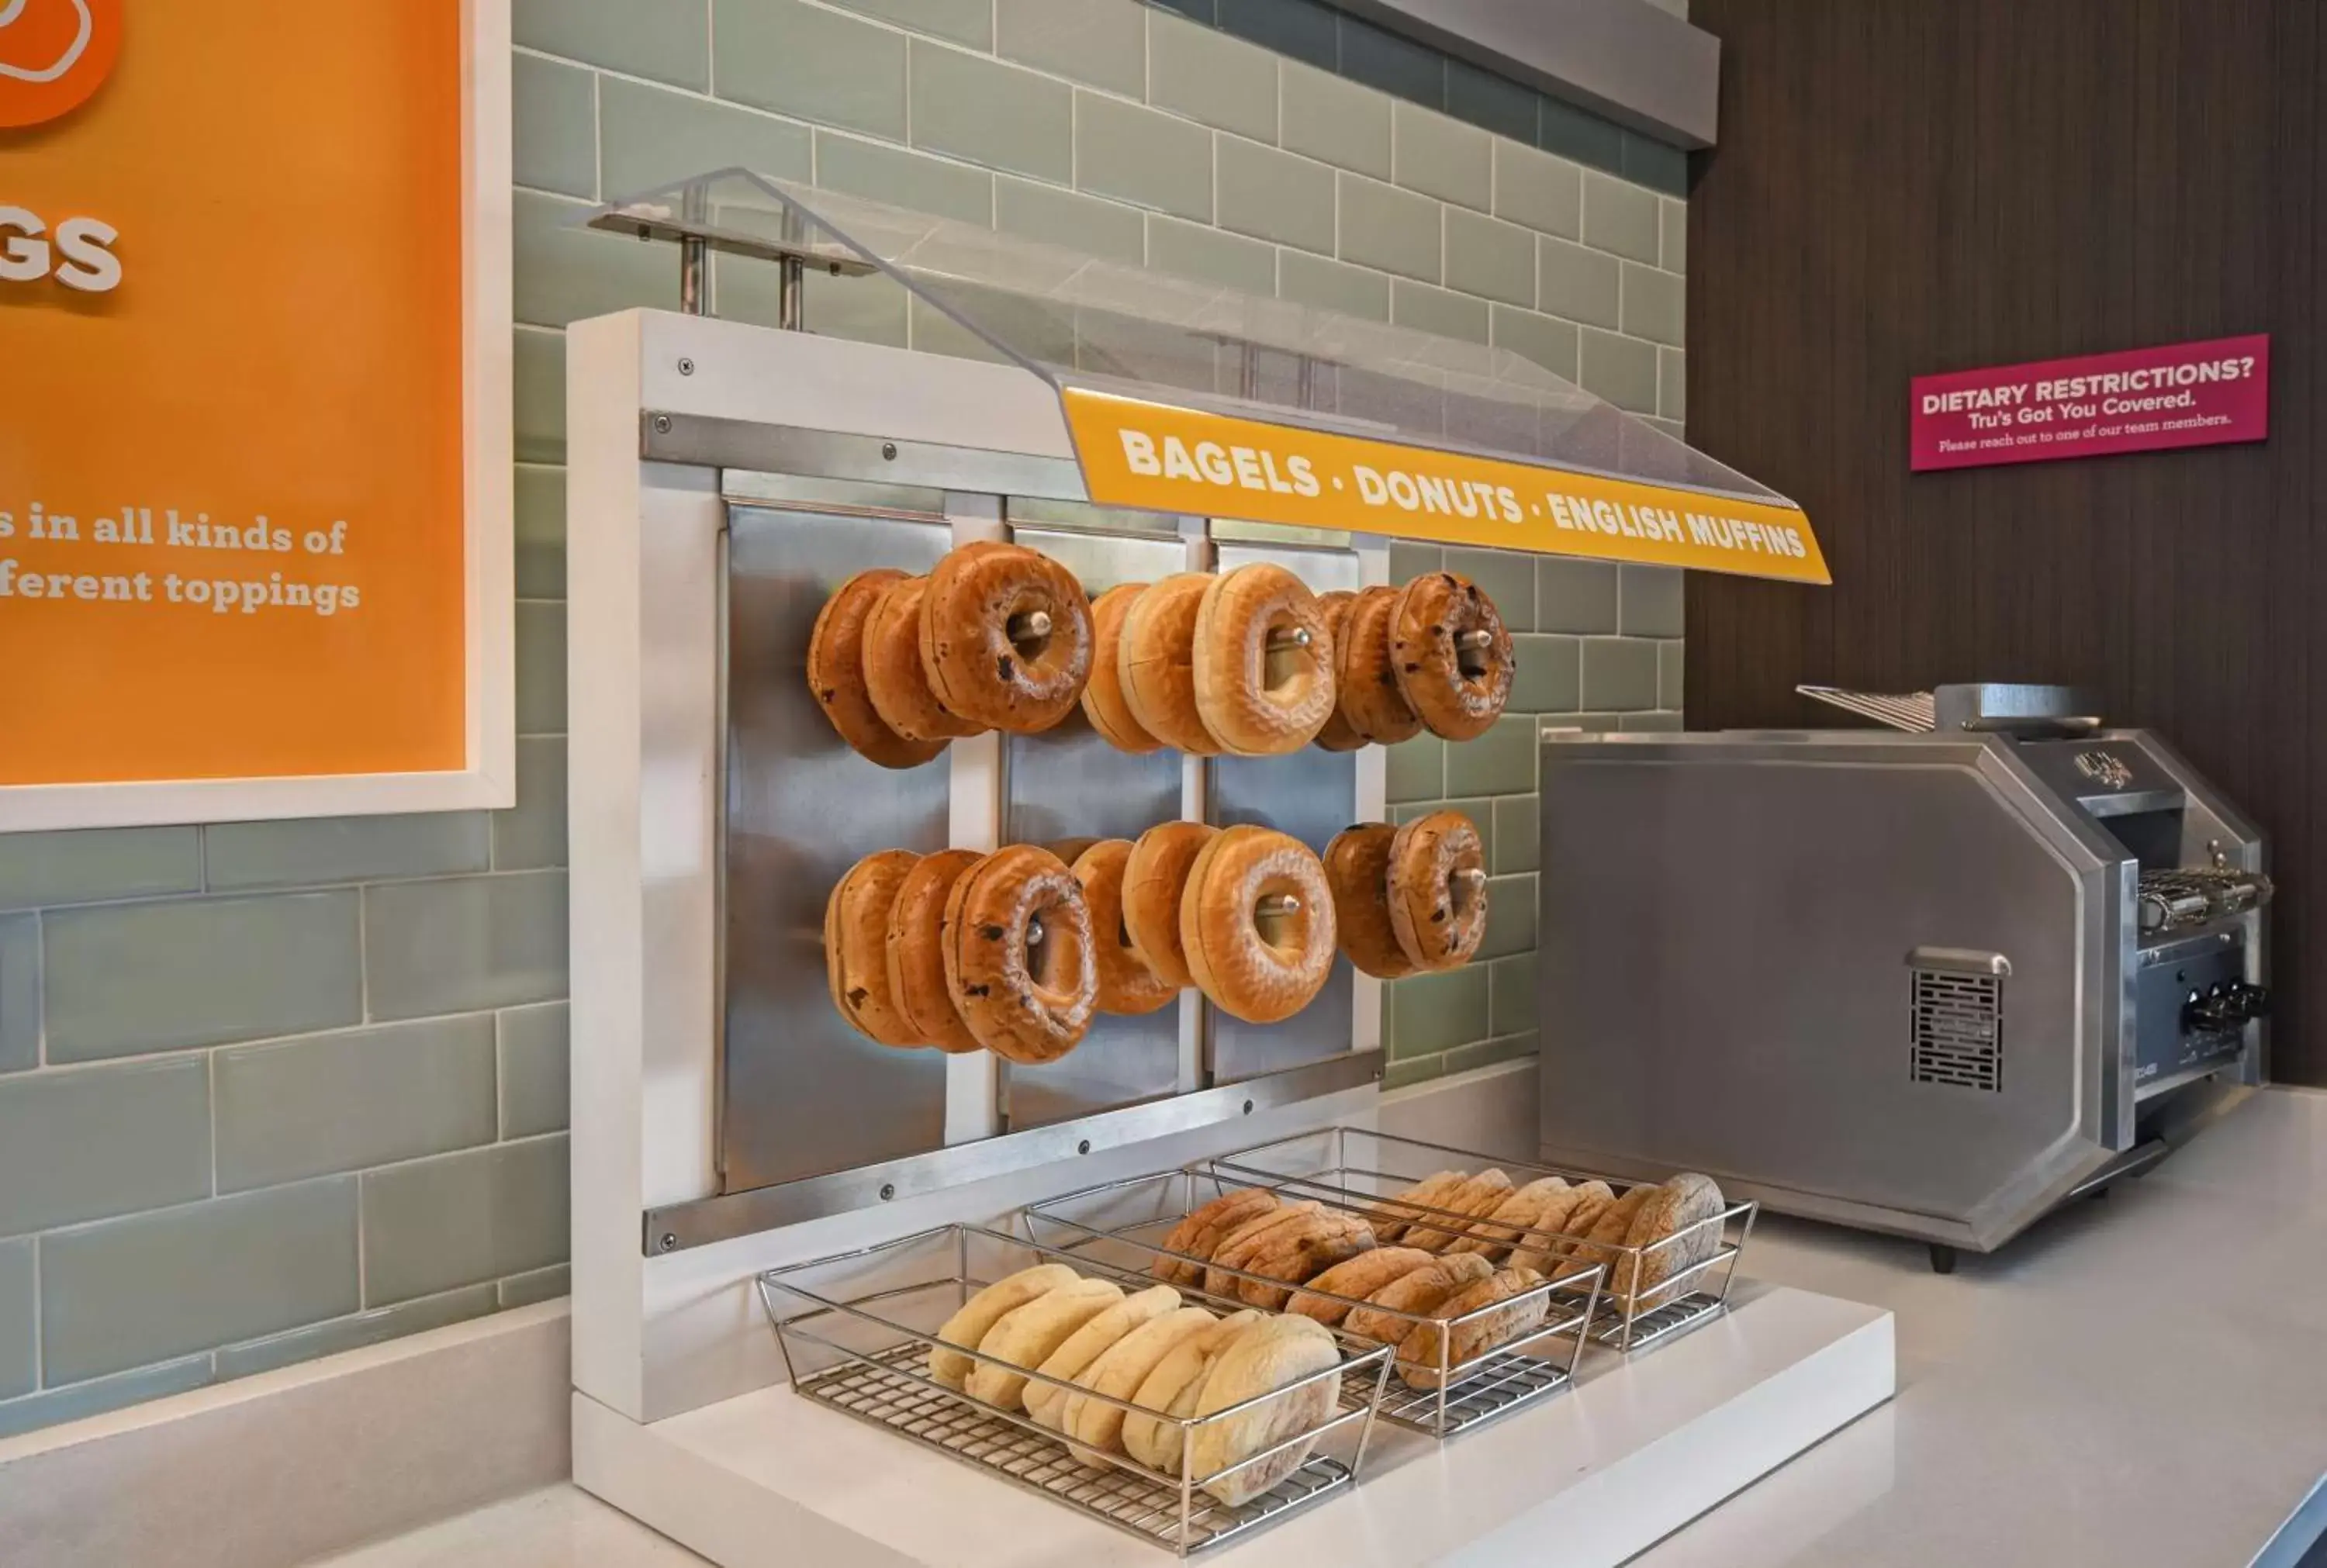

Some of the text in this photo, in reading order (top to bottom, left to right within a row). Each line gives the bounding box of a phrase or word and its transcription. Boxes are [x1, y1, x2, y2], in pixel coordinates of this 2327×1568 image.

[1923, 357, 2254, 414] DIETARY RESTRICTIONS?
[1968, 389, 2196, 430] Tru's Got You Covered.
[1938, 413, 2232, 453] Please reach out to one of our team members.
[1119, 429, 1807, 558] BAGELS DONUTS ENGLISH MUFFINS
[29, 502, 80, 541] in
[94, 507, 154, 544] all
[166, 509, 292, 551] kinds
[303, 521, 347, 554] of
[164, 572, 360, 616] toppings
